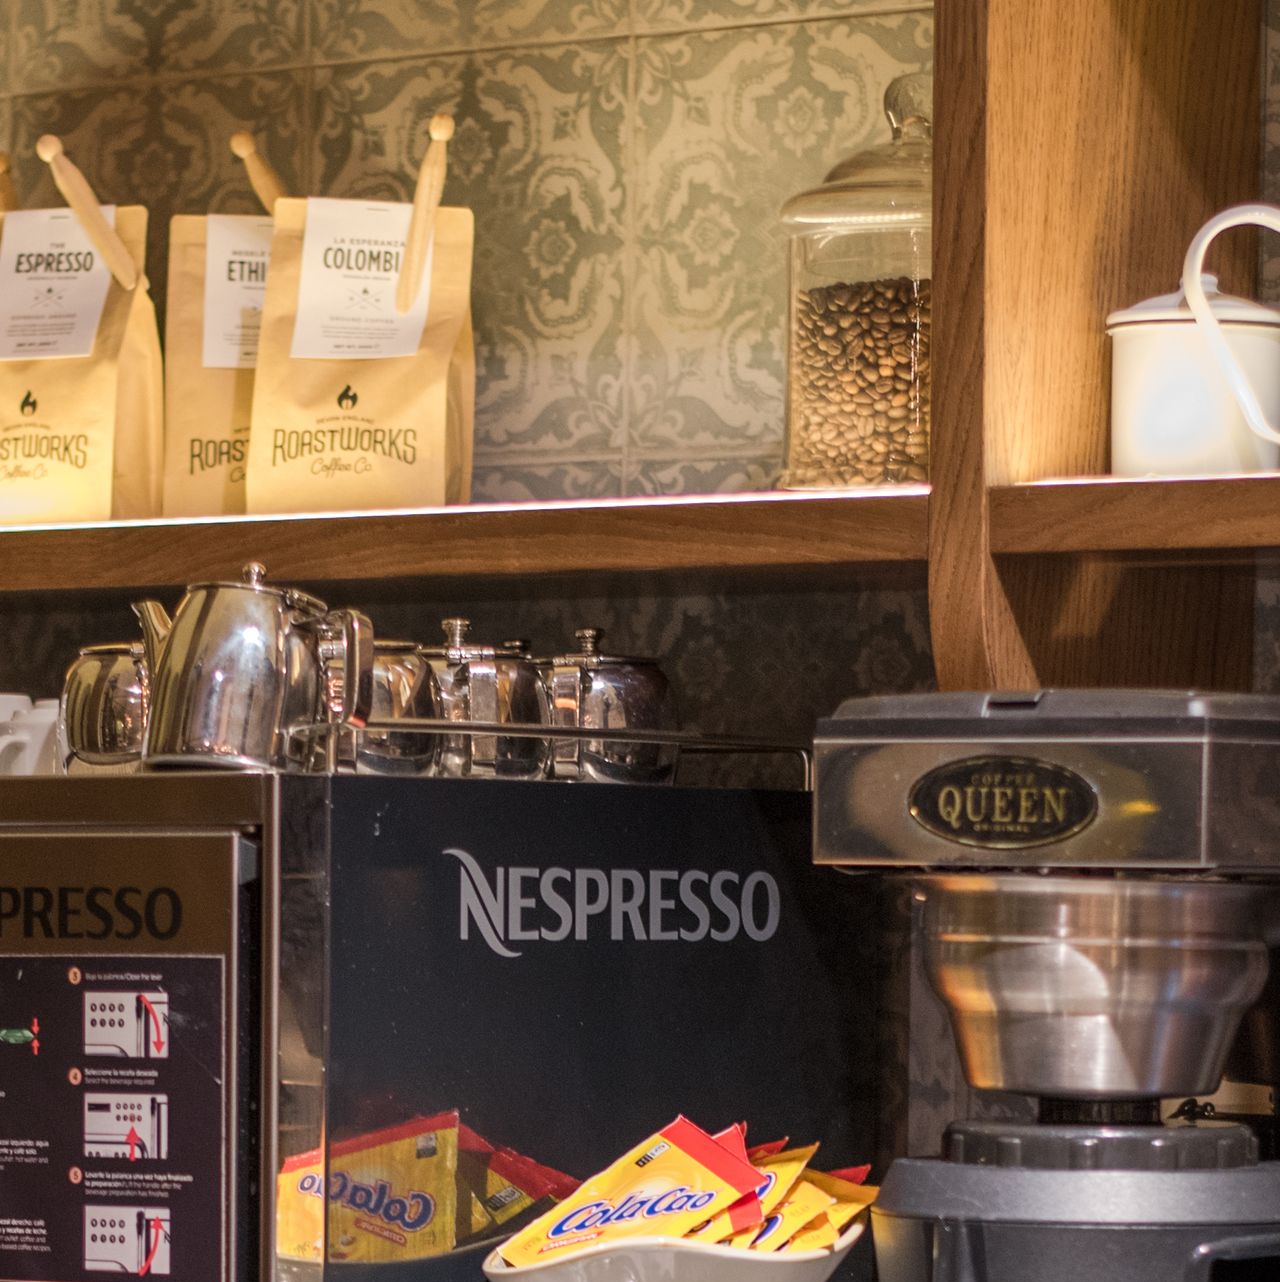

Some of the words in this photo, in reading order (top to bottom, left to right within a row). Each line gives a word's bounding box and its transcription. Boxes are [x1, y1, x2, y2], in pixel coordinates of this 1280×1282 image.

[14, 251, 94, 274] ESPRESSO
[227, 260, 266, 282] ETHI
[323, 247, 400, 273] COLOMBI
[272, 426, 417, 467] ROASTWORKS
[311, 457, 353, 479] Coffee
[937, 786, 1069, 829] QUEEN
[442, 848, 781, 958] NESPRESSO
[548, 1185, 717, 1240] ColaCao
